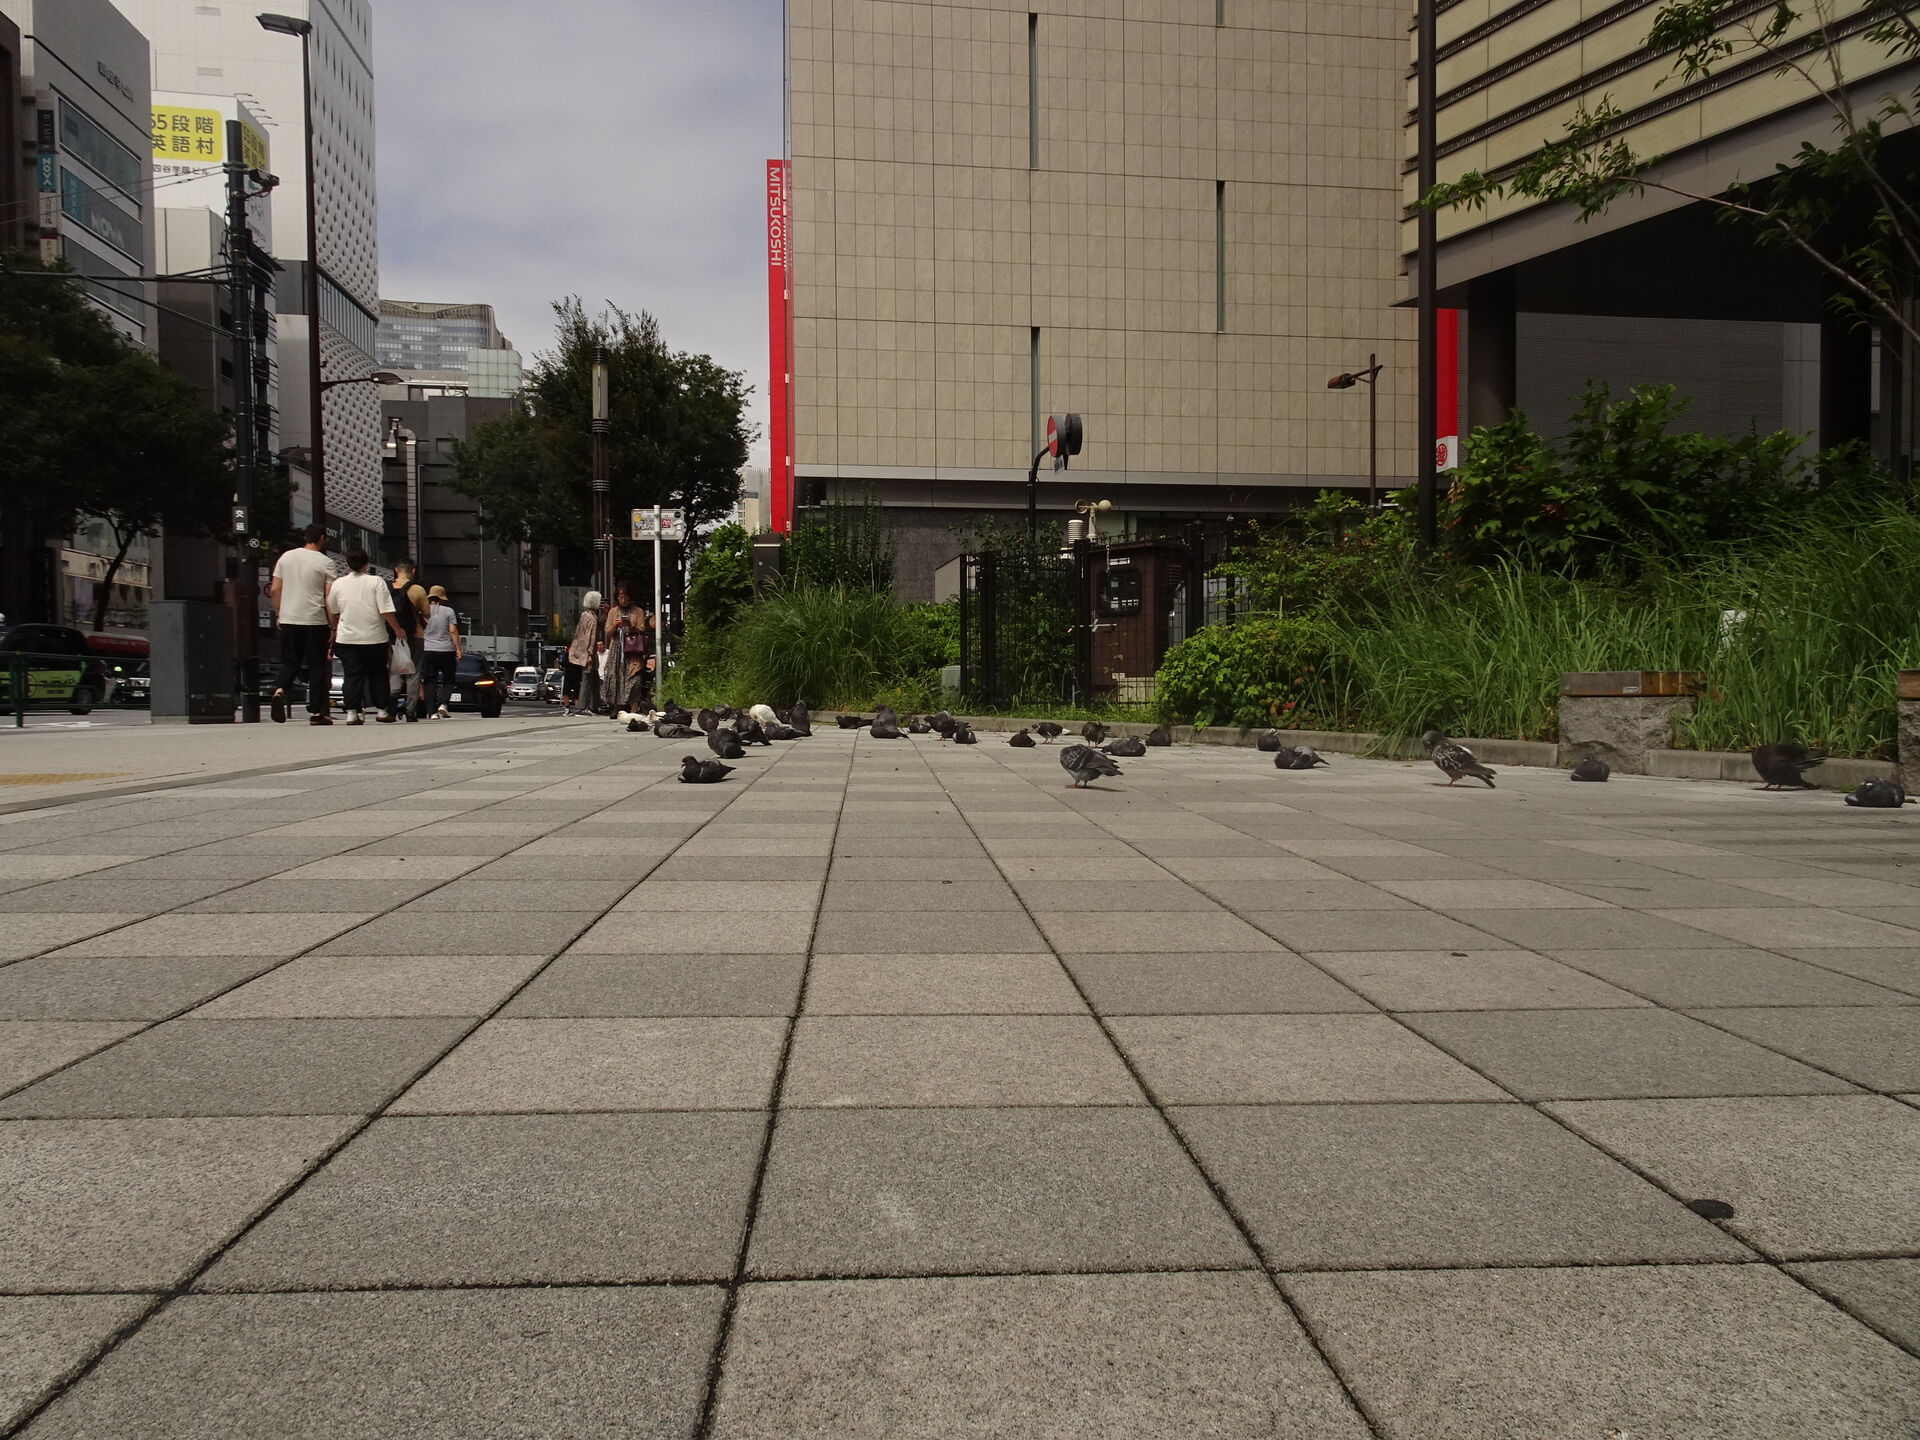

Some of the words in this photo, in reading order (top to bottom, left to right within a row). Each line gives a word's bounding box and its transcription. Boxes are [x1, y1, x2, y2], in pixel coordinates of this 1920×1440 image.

[152, 134, 215, 154] 英語村
[42, 157, 51, 185] NOVA
[769, 167, 782, 266] MITSUKOSHI
